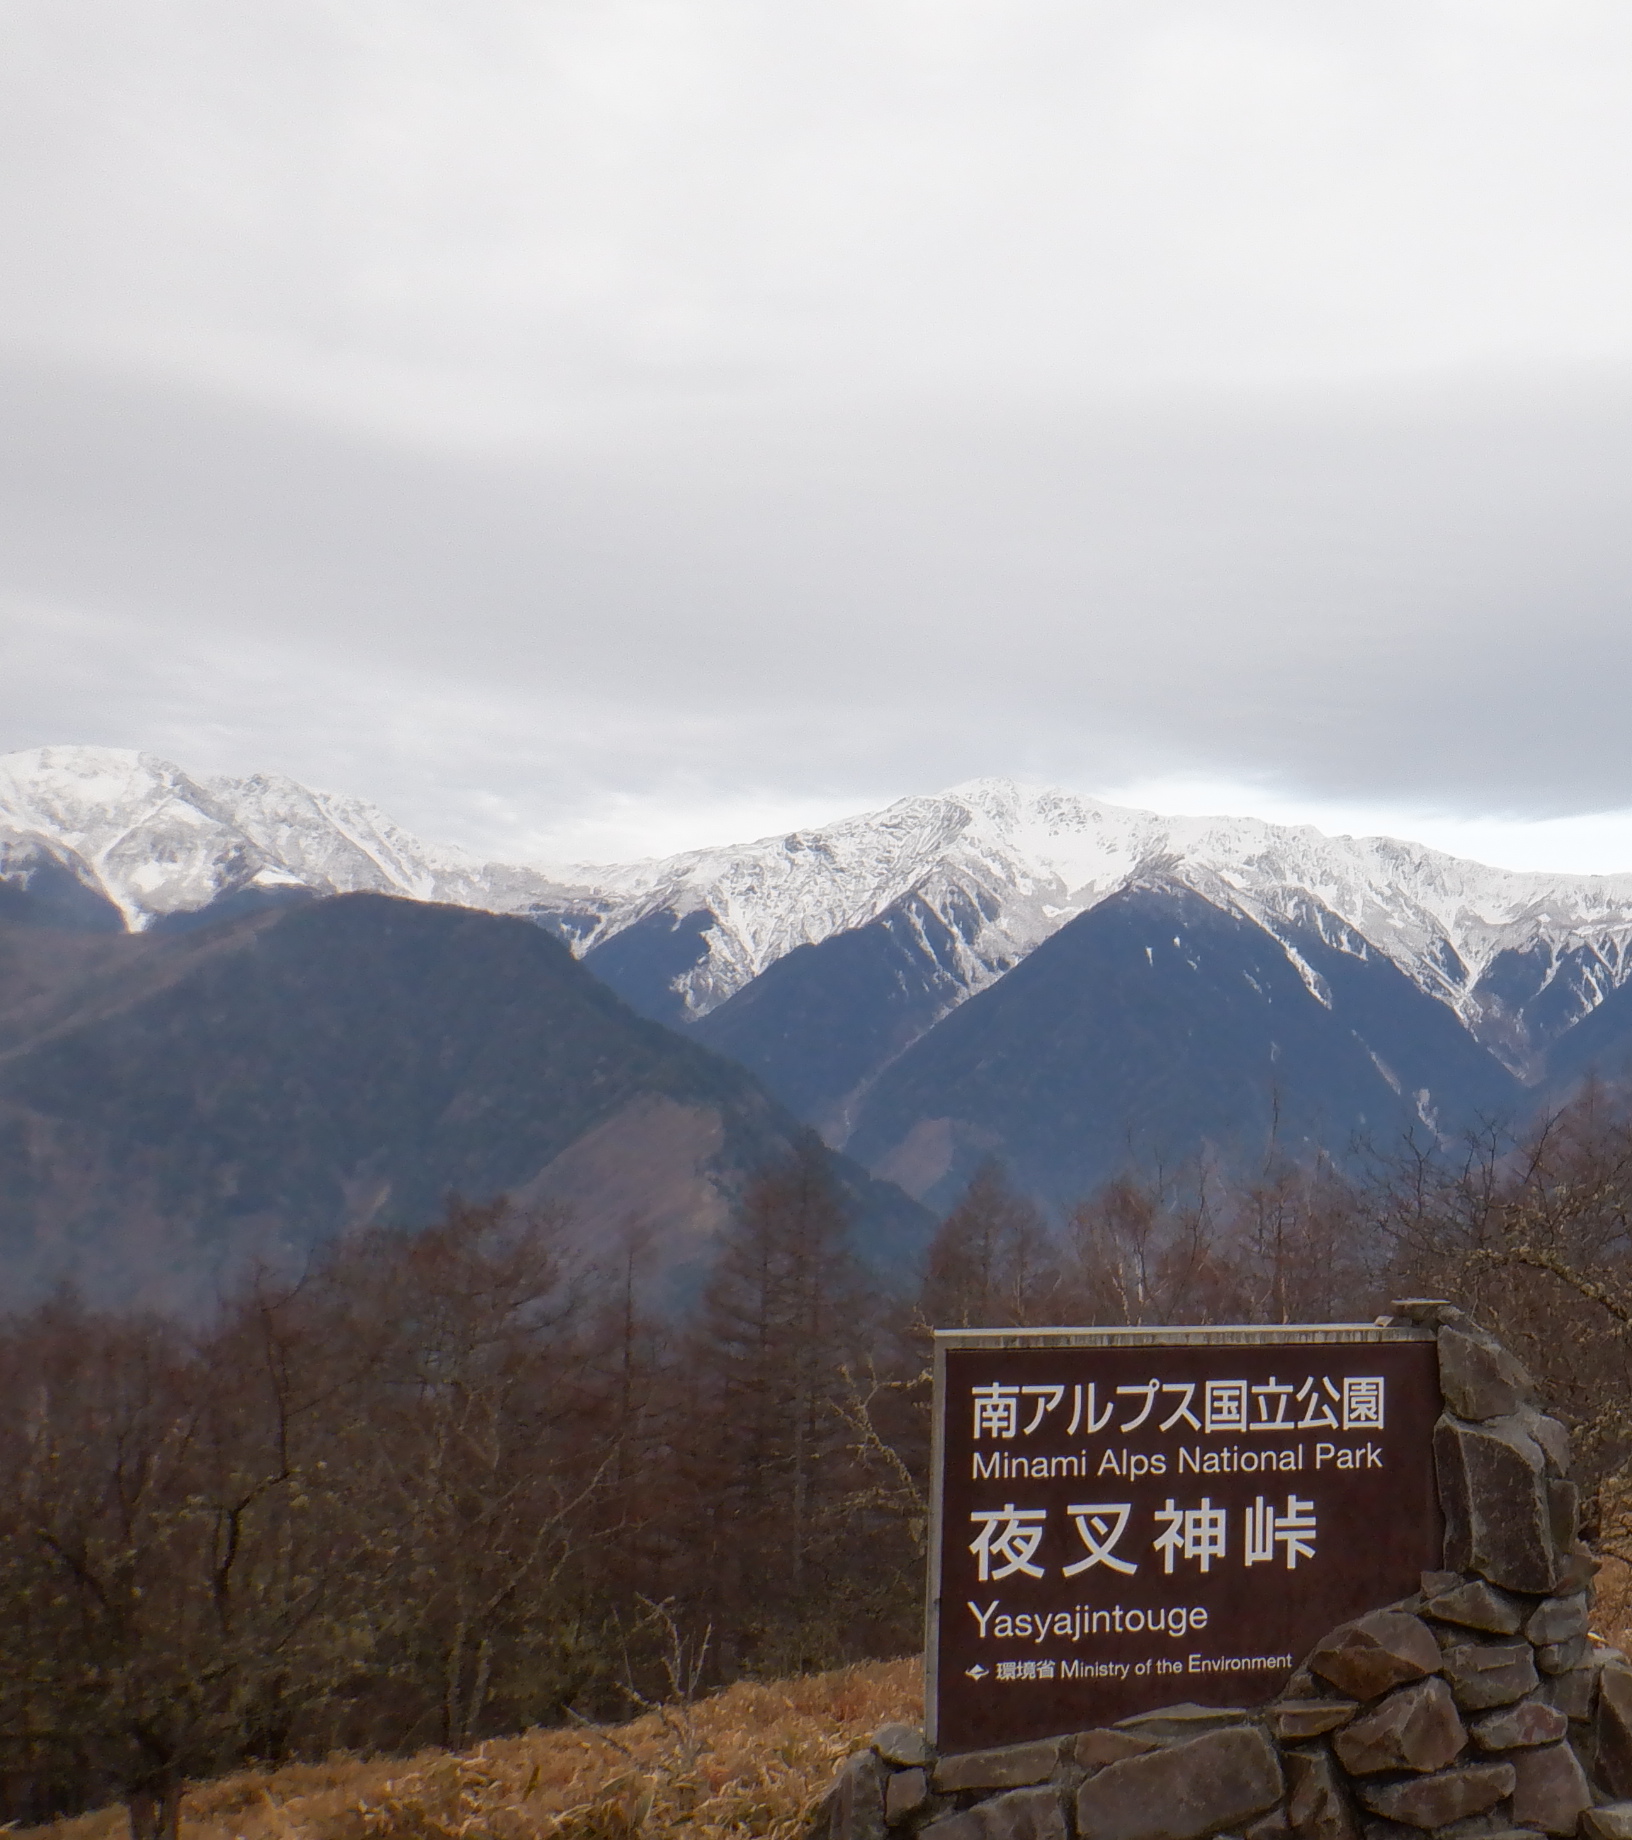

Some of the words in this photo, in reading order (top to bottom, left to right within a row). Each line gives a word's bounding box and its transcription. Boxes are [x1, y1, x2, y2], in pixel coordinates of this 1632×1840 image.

[972, 1376, 1385, 1439] 南アルプス国立公園
[973, 1450, 1087, 1480] Minami
[1097, 1449, 1167, 1482] Alps
[1179, 1444, 1303, 1474] National
[1316, 1442, 1383, 1470] Park
[969, 1494, 1317, 1582] 夜叉神峠
[968, 1600, 1208, 1643] Yasyajintouge
[995, 1660, 1056, 1681] 環境省
[1061, 1660, 1130, 1680] Ministry
[1135, 1659, 1152, 1676] of
[1156, 1659, 1183, 1675] the
[1188, 1654, 1292, 1674] Environment
